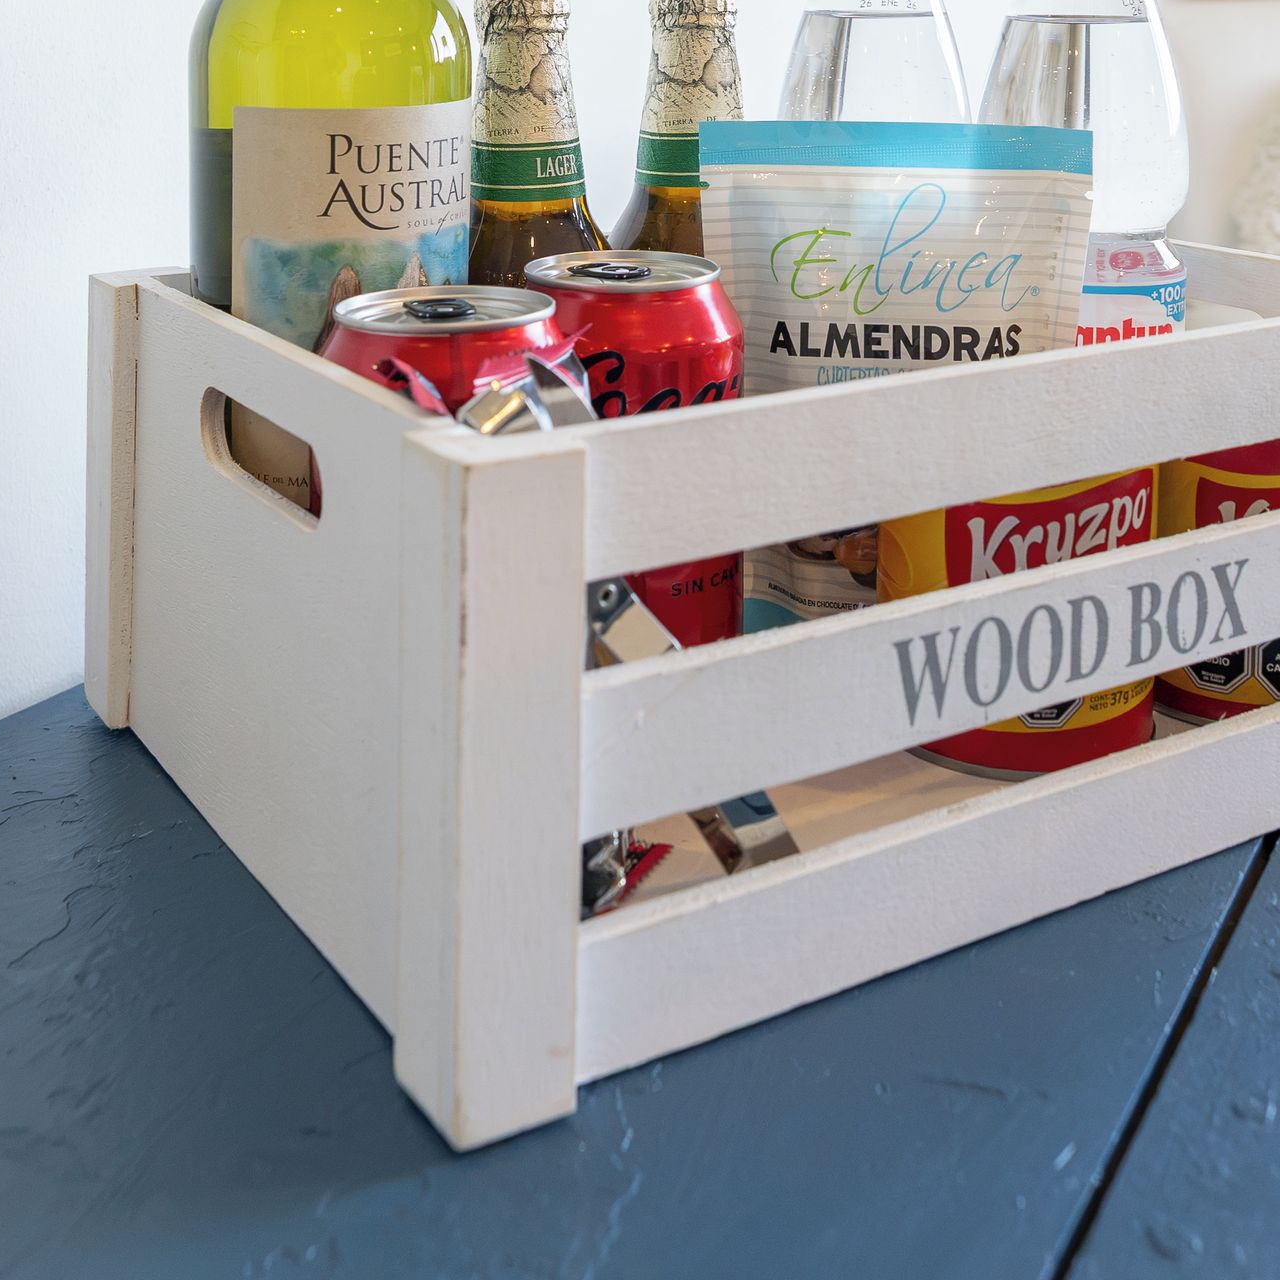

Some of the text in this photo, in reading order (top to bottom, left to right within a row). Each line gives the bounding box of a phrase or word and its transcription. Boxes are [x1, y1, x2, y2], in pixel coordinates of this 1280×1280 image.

[860, 0, 872, 8] 26
[487, 127, 520, 137] TIERRA
[664, 118, 694, 128] TIERRA
[325, 133, 459, 175] PUENTE
[535, 154, 578, 178] LAGER
[316, 172, 467, 231] AUSTRAL
[407, 218, 435, 229] SOUL
[770, 321, 1023, 362] ALMENDRAS
[287, 476, 309, 488] MA
[967, 487, 1147, 582] Kryzpo
[671, 577, 704, 597] SIN
[816, 600, 853, 611] CHOCOLATE
[893, 558, 1250, 728] WOOD BOX
[1205, 656, 1231, 667] DIO
[1110, 690, 1130, 708] 37g
